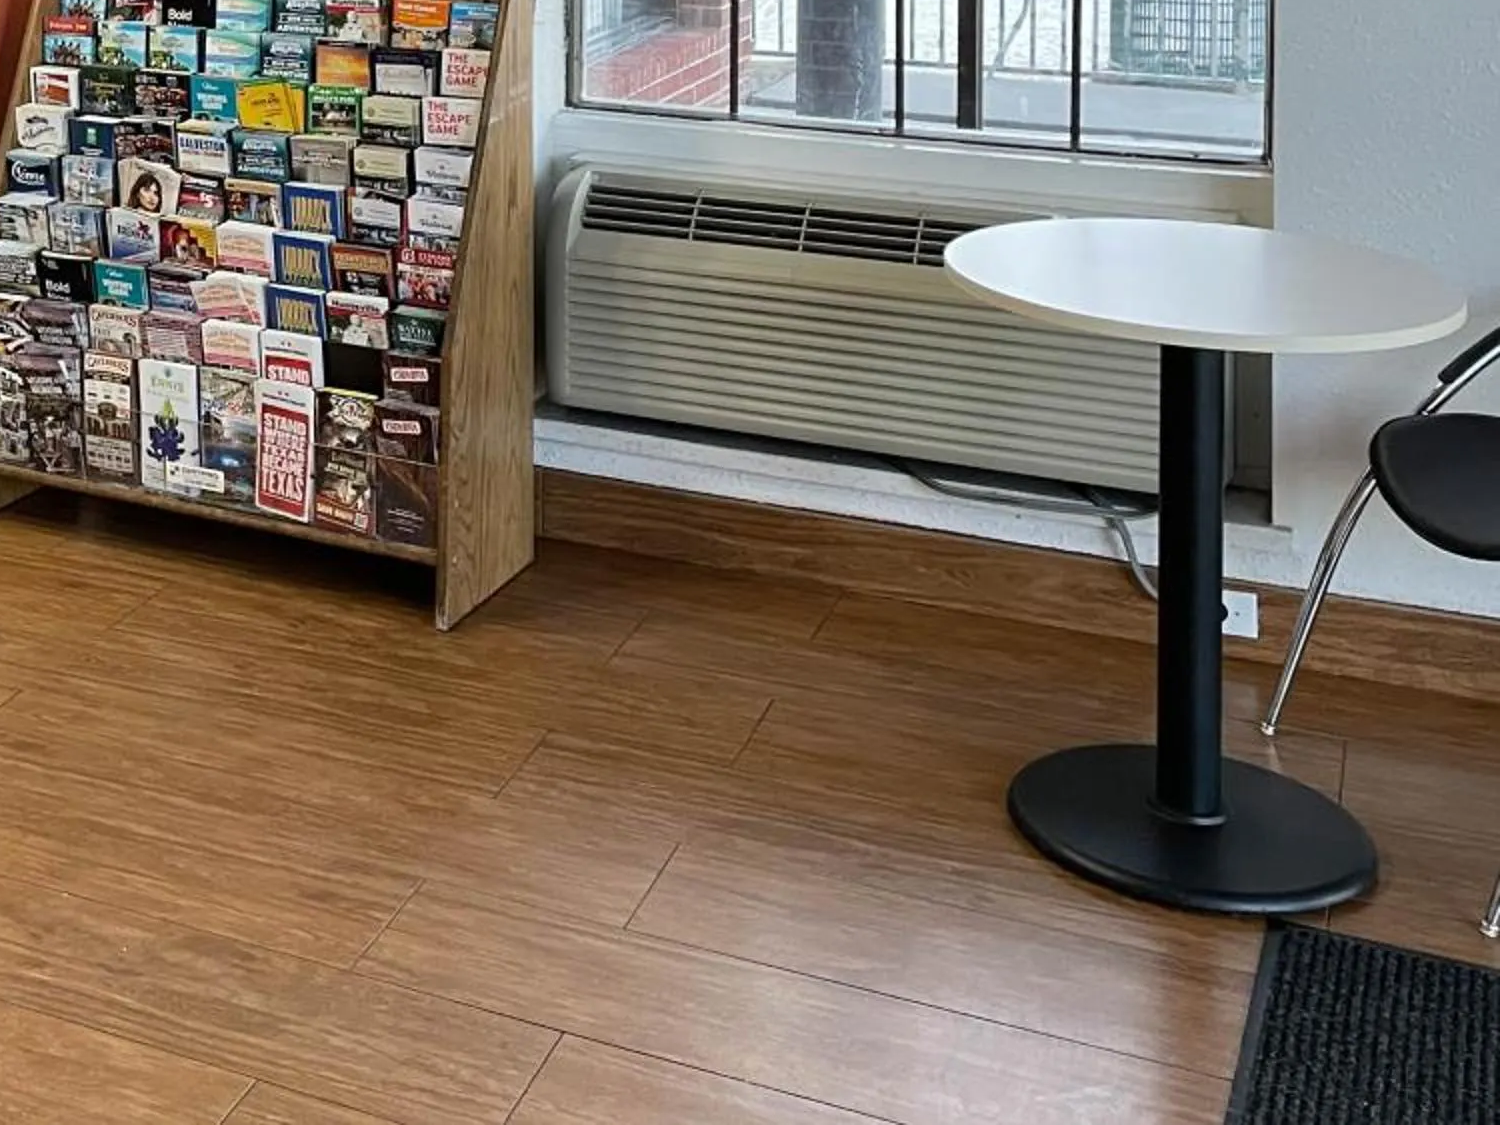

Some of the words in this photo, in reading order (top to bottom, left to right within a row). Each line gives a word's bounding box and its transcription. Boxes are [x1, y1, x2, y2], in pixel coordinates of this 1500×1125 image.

[167, 8, 193, 22] Bold
[447, 52, 469, 64] THE
[445, 75, 477, 87] GAME
[427, 100, 449, 112] THE
[427, 112, 471, 125] ESCAPE
[427, 125, 460, 136] GAME
[179, 136, 225, 152] GALVESTON
[45, 279, 71, 294] Bold
[267, 364, 311, 386] STAND
[263, 412, 307, 436] STAND
[260, 469, 304, 503] TEXAS
